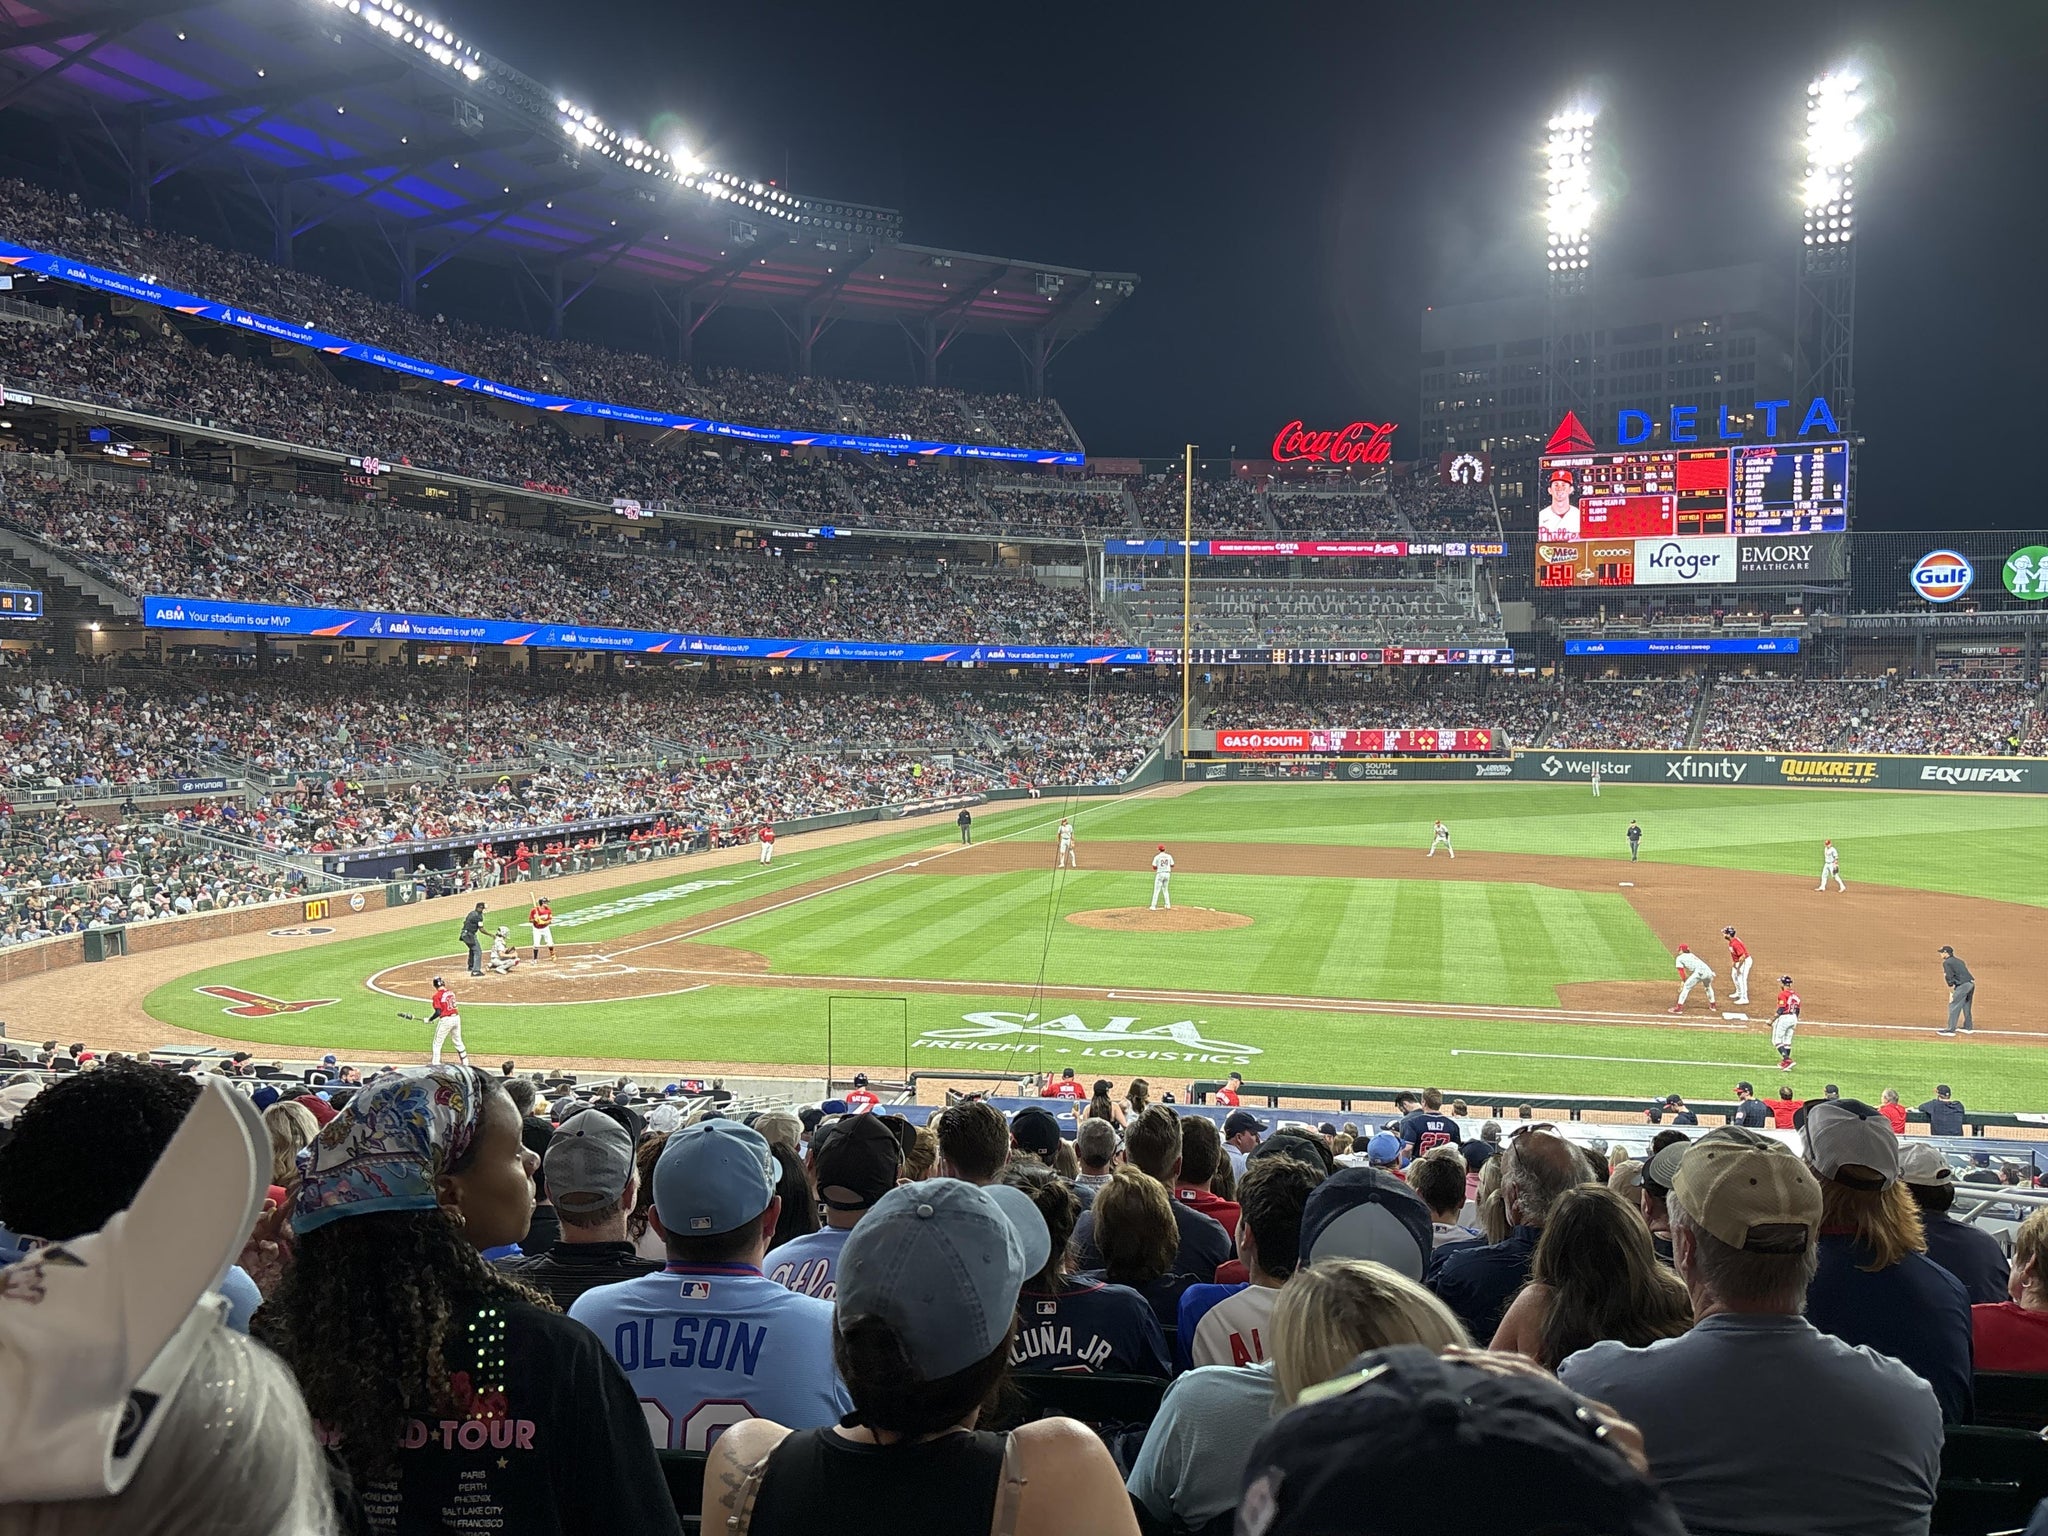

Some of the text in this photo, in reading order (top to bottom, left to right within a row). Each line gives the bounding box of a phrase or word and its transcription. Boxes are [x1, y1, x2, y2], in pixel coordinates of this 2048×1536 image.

[67, 268, 87, 280] ABM
[88, 274, 103, 283] Your
[104, 278, 129, 292] stadium
[135, 288, 146, 296] our
[147, 290, 161, 300] MVP
[237, 316, 253, 326] ABM
[254, 320, 266, 330] Your
[267, 325, 287, 335] stadium
[301, 333, 313, 342] MVP
[1618, 397, 1839, 445] DELTA
[1272, 419, 1398, 464] Coca-Cola
[1741, 447, 1777, 458] Braves
[363, 456, 379, 475] 44
[1614, 484, 1625, 494] 54
[624, 505, 640, 519] 47
[820, 526, 835, 538] 42
[1408, 544, 1442, 554] 8:51 PM
[1470, 544, 1502, 555] $15,033
[1553, 547, 1577, 556] MEGA
[1742, 545, 1813, 563] EMORY
[1650, 543, 1720, 579] Kroger
[1742, 562, 1809, 571] HEALTHCARE
[1546, 565, 1572, 579] 150
[1916, 568, 1967, 584] Gulf
[3, 597, 32, 611] HR 2
[1215, 594, 1445, 614] HANK AARON TERRACE
[156, 606, 184, 621] ABM
[189, 611, 209, 622] Your
[211, 612, 245, 624] stadium
[247, 615, 254, 625] is
[271, 616, 291, 627] MVP
[389, 621, 410, 633] ABM
[411, 625, 427, 634] Your
[428, 625, 453, 635] stadium
[453, 627, 459, 635] is
[471, 628, 486, 637] MVP
[561, 632, 577, 642] ABM
[578, 634, 589, 642] Your
[590, 635, 608, 644] stadium
[622, 637, 634, 646] MVP
[690, 641, 703, 650] ABM
[1757, 642, 1776, 650] ABM
[825, 646, 840, 655] ABM
[854, 649, 874, 657] stadium
[988, 650, 1005, 658] ABM
[1126, 652, 1142, 660] ABM
[1224, 736, 1302, 746] GAS SOUTH
[1311, 736, 1327, 746] AL
[1330, 731, 1346, 739] MIN
[1385, 731, 1400, 739] LAA
[1438, 731, 1456, 739] WSH
[1566, 761, 1631, 774] Wellstar
[1666, 756, 1747, 782] xfinity
[1780, 759, 1876, 777] QUIKRETE
[1920, 765, 2025, 784] EQUIFAX
[194, 781, 223, 789] HYUNDAI
[306, 900, 328, 919] 007
[920, 1011, 1264, 1054] SAIA
[910, 1039, 1251, 1065] FREIGHT LOGISTICS
[1426, 1121, 1444, 1131] RILEY
[1420, 1132, 1450, 1156] 27
[769, 1258, 837, 1301] Atla
[614, 1317, 767, 1376] OLSON
[1009, 1321, 1112, 1371] CUÑA JR.
[439, 1419, 535, 1450] TOUR
[461, 1471, 486, 1479] PARIS
[459, 1483, 487, 1491] PERTH
[454, 1495, 491, 1503] PHOENIX
[442, 1507, 503, 1516] SALT LAKE CITY
[457, 1519, 503, 1528] FRANCISCO
